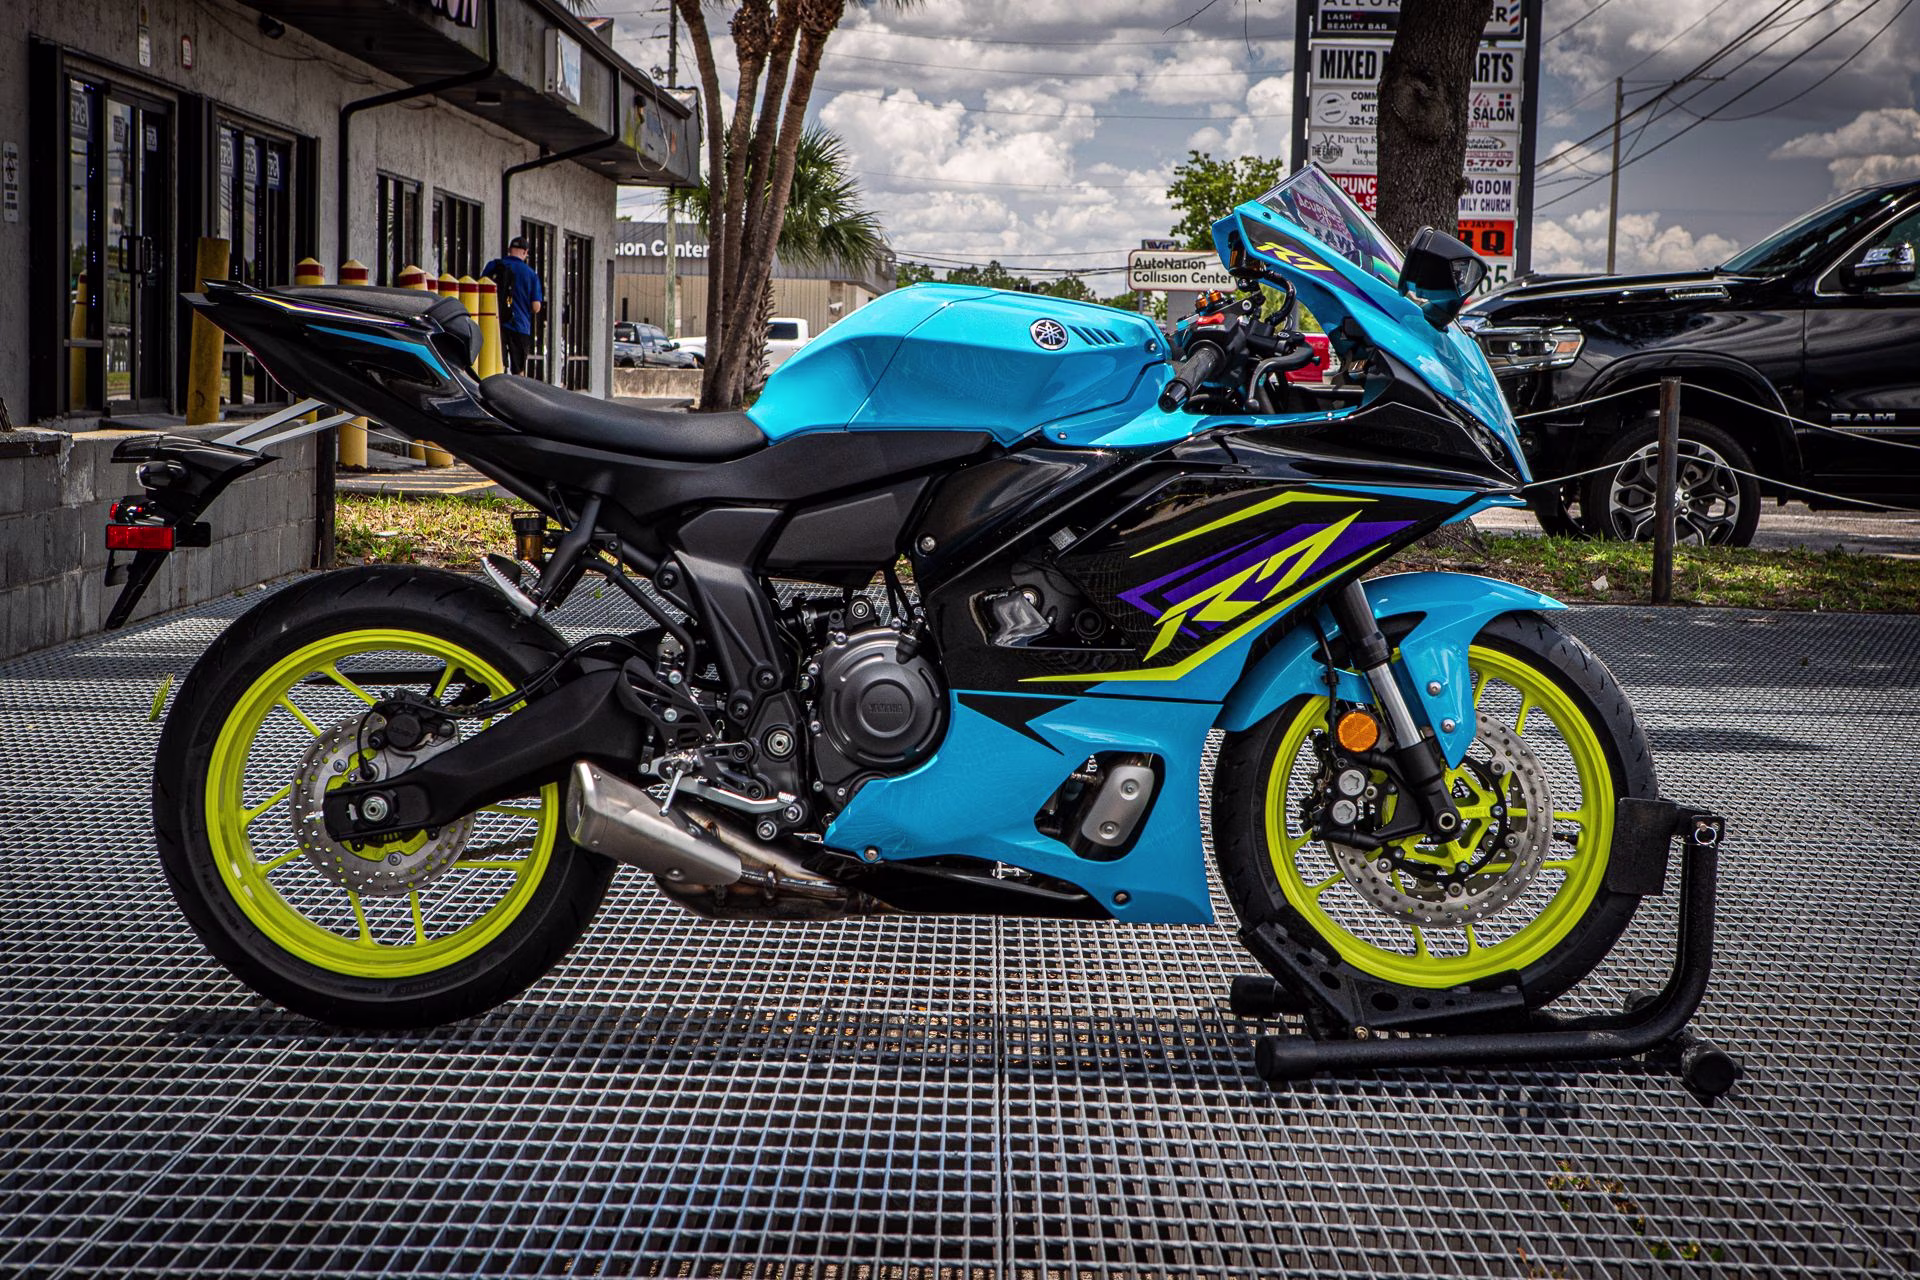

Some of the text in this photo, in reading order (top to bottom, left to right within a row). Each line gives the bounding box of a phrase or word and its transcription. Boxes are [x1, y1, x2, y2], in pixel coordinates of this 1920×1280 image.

[1326, 22, 1365, 30] BEAUTY
[1319, 49, 1377, 79] MIXED
[1473, 107, 1515, 121] SALON
[1337, 135, 1368, 144] Puerto
[1466, 159, 1513, 168] 5-7707
[1481, 198, 1511, 212] CHURCH
[1134, 257, 1206, 270] AutoNation
[1133, 271, 1233, 284] Collision Center
[1831, 412, 1896, 421] RAM
